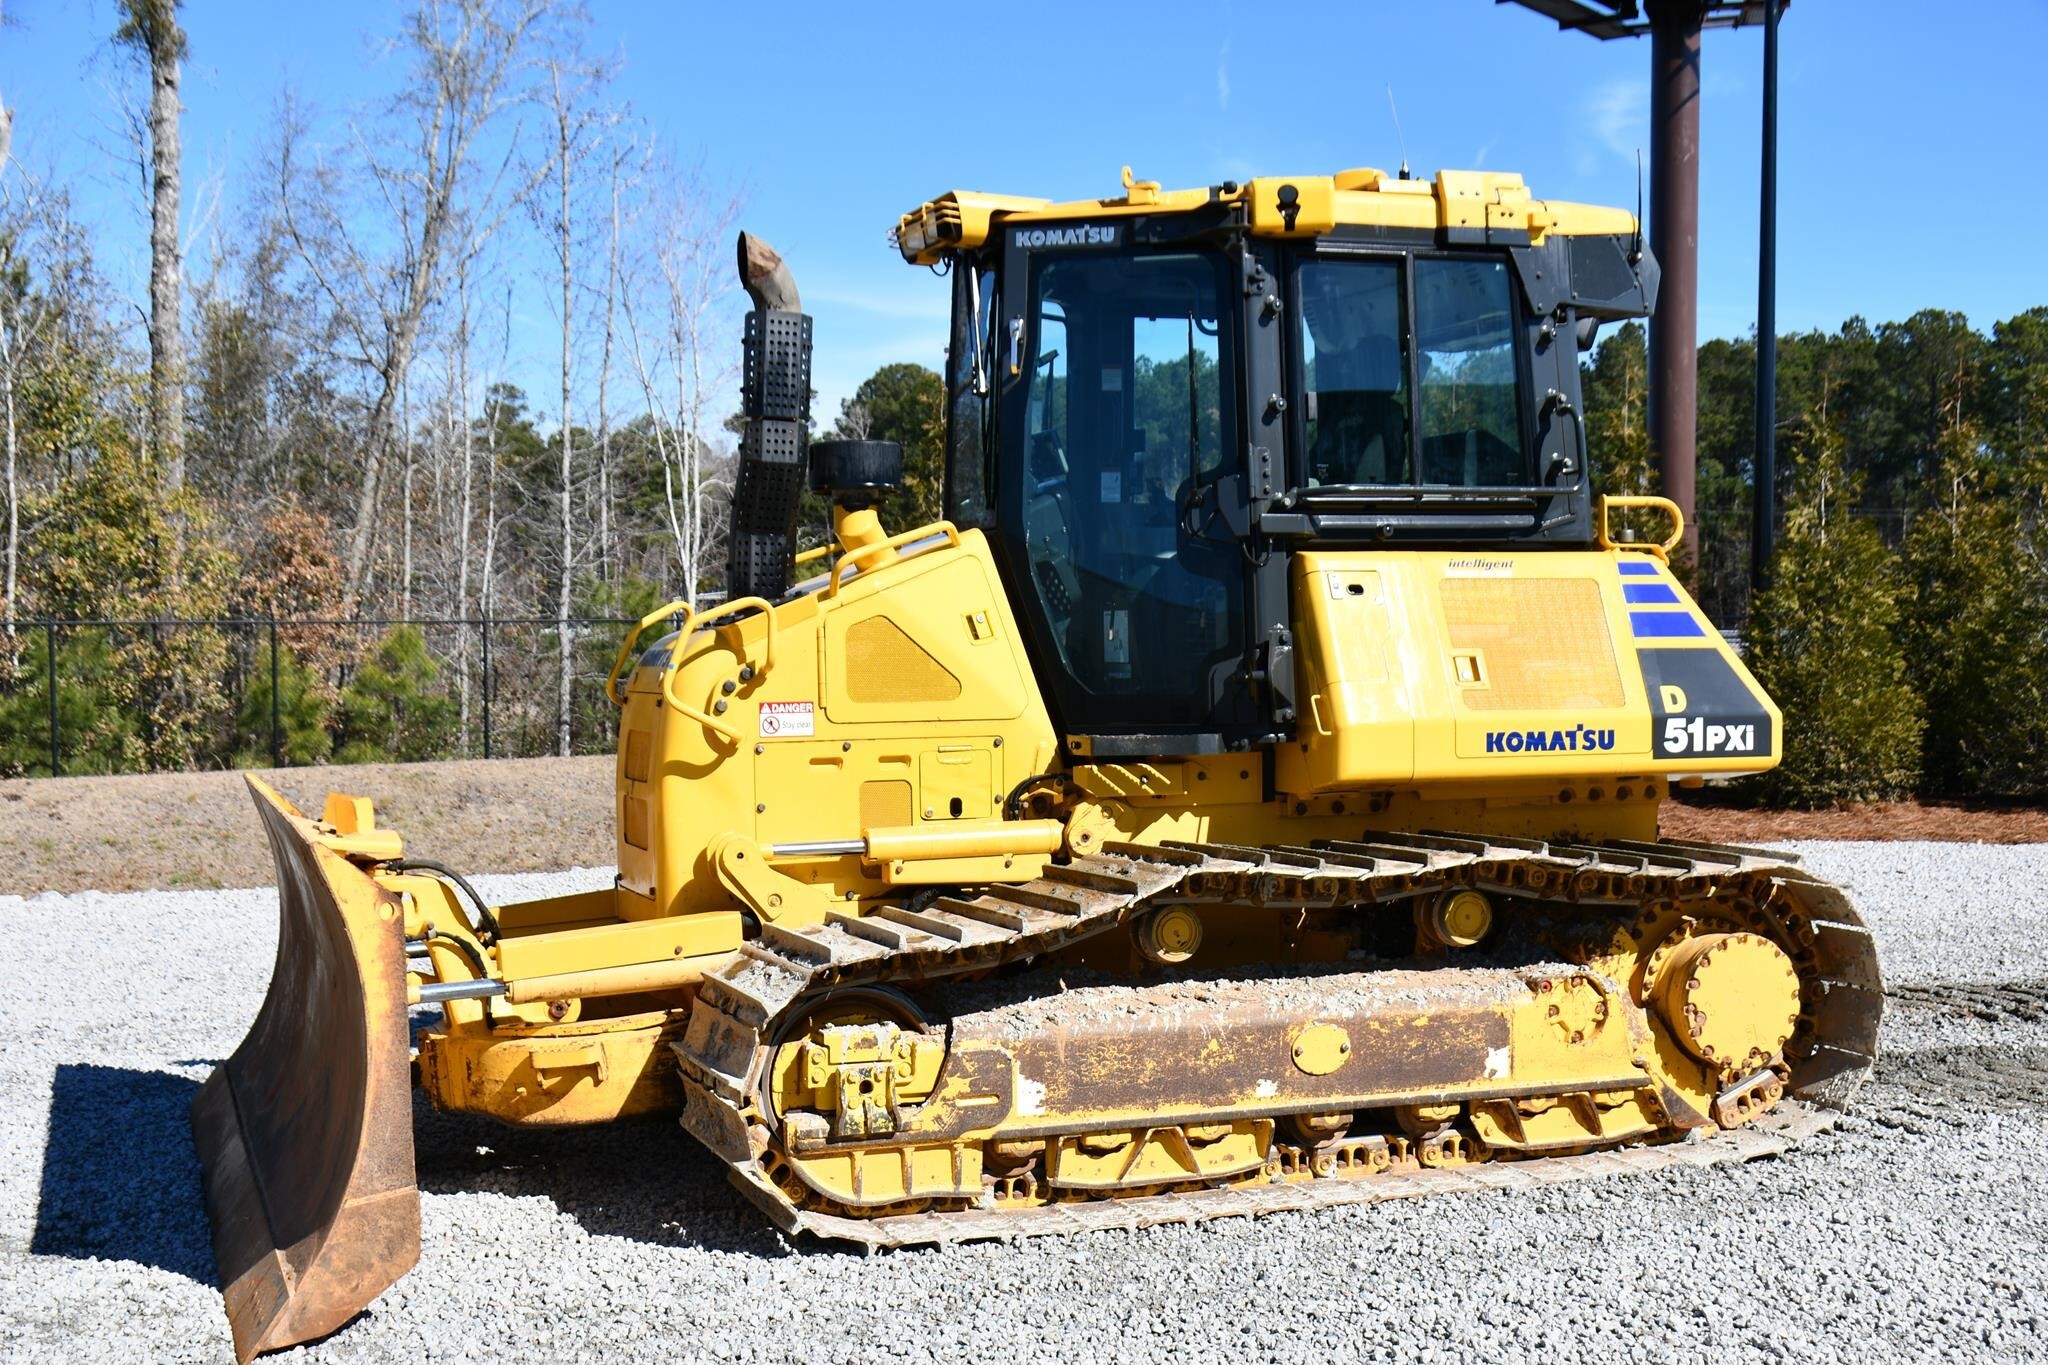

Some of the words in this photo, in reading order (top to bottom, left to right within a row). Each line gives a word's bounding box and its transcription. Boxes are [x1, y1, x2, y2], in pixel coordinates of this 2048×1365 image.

[1015, 224, 1115, 247] KOMATSU
[1448, 558, 1514, 571] intelligent
[771, 703, 813, 713] DANGER
[1660, 685, 1687, 713] D
[782, 721, 795, 730] Stay
[1663, 717, 1754, 753] 51PXi
[1486, 724, 1615, 753] KOMATSU
